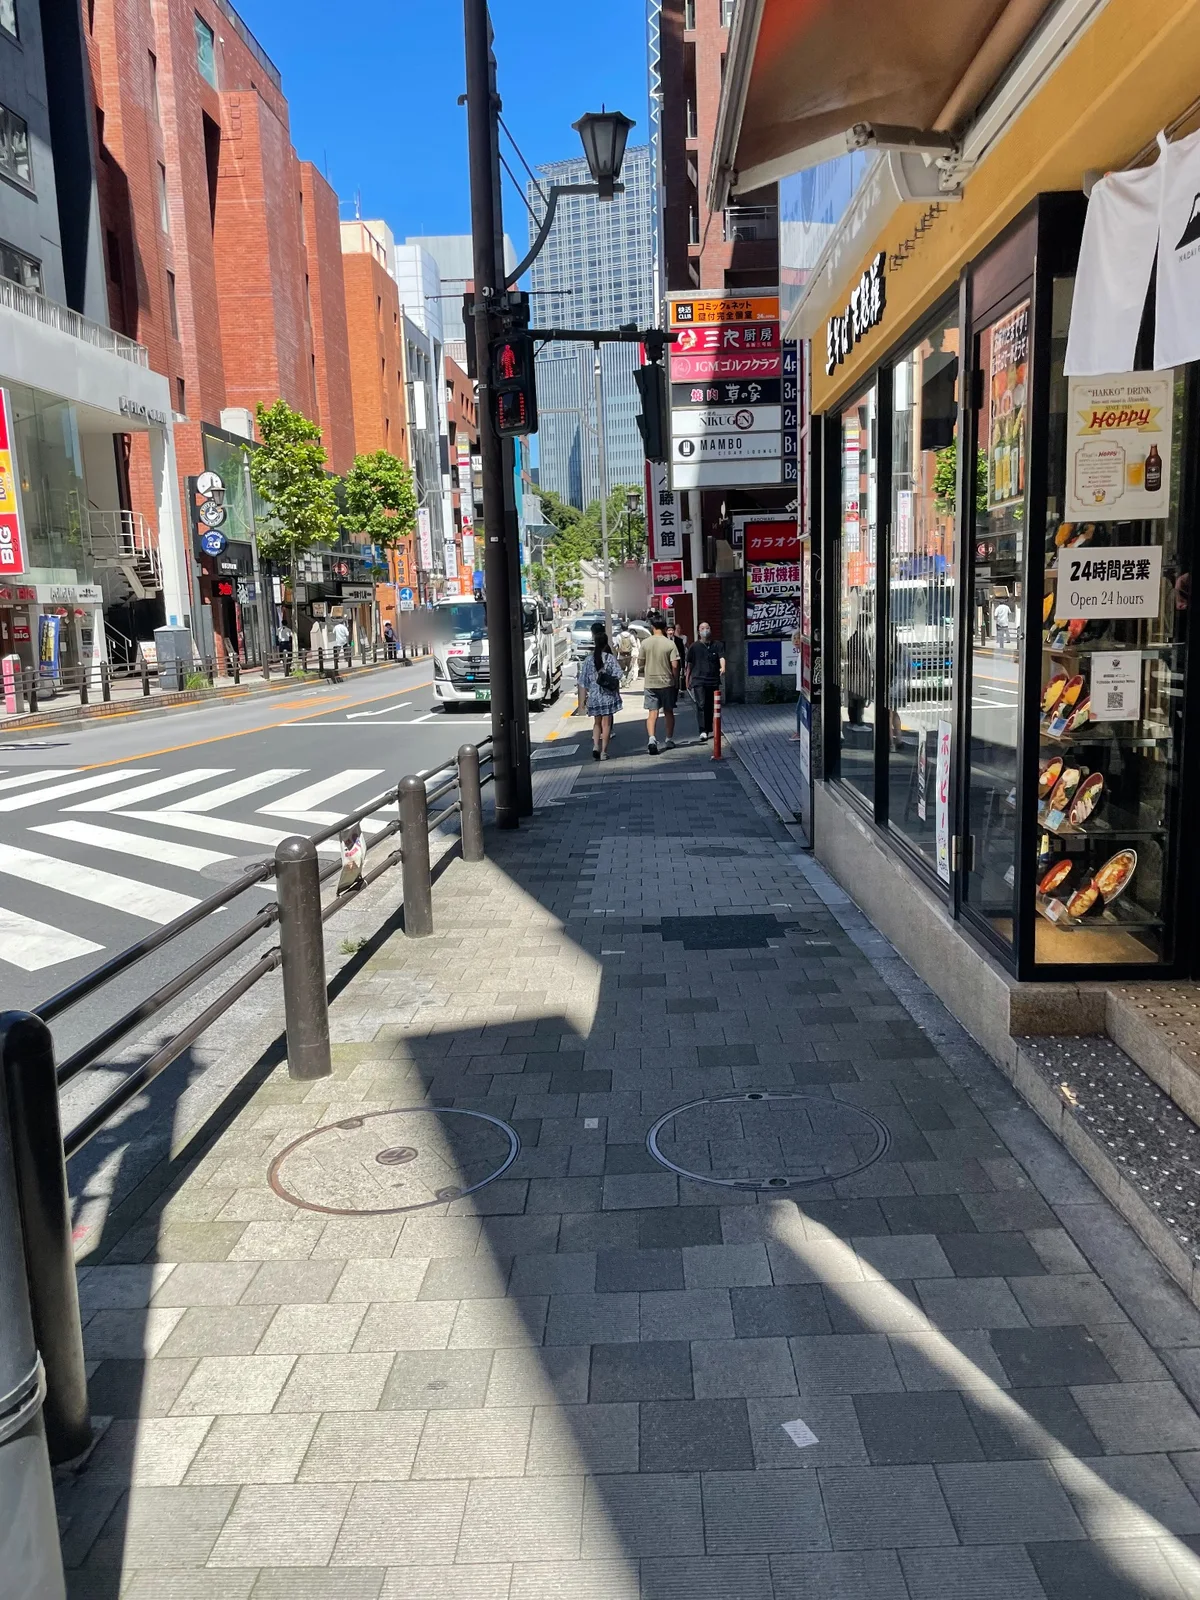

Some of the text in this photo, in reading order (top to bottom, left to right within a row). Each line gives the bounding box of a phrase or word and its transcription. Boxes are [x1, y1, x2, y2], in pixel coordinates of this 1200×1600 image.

[698, 301, 752, 311] コミック&ネット
[694, 357, 780, 373] JGMゴルフクラブ
[784, 354, 797, 372] 4F
[784, 382, 797, 400] 3F
[1127, 386, 1152, 395] DRINK
[784, 409, 797, 426] 2F
[700, 438, 742, 450] MAMBO
[784, 436, 797, 453] B1
[784, 463, 797, 480] B2
[750, 536, 798, 549] カラオケ
[751, 566, 800, 584] 最新機種
[1070, 559, 1150, 581] 24時間営業
[1070, 591, 1144, 610] Open 24 hours
[759, 650, 770, 658] 3F
